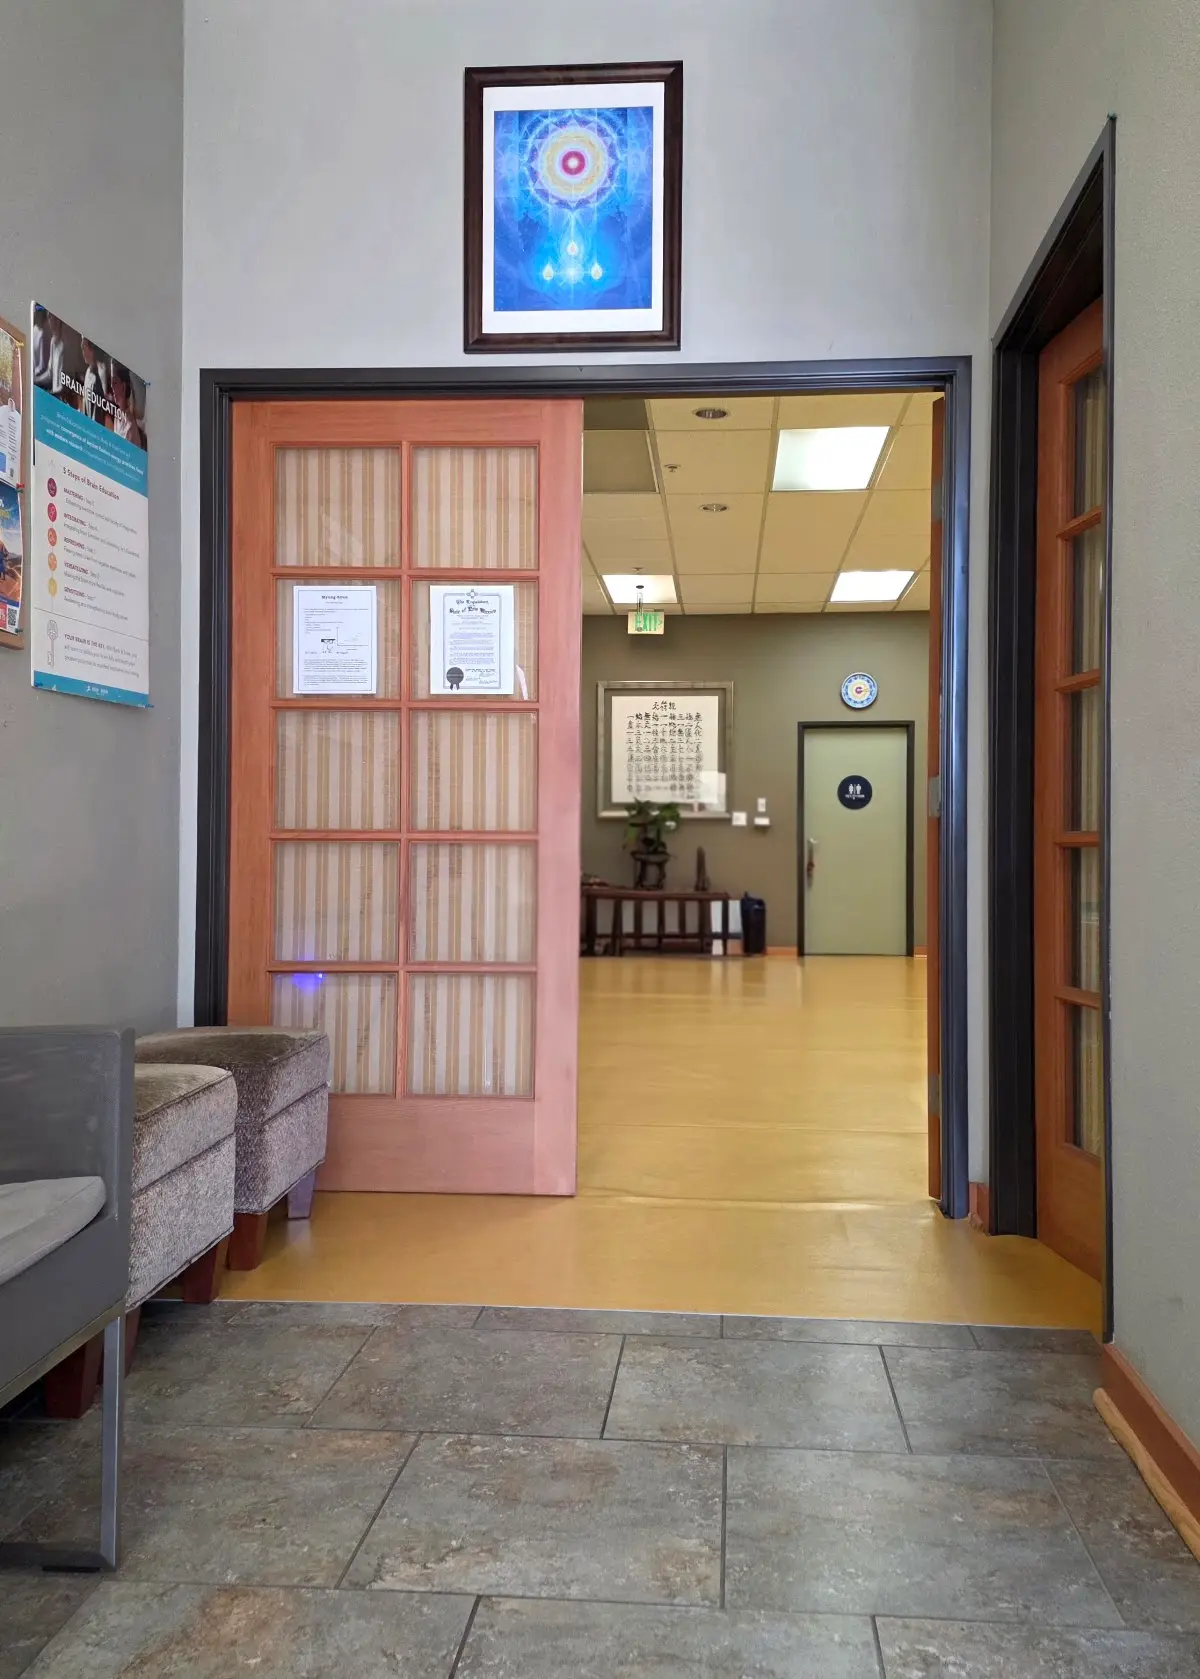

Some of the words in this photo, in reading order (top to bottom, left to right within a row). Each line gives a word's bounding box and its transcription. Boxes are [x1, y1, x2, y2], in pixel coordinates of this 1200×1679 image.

[60, 371, 85, 398] BRAIN
[86, 388, 128, 423] EDUCATION
[63, 465, 66, 474] 5
[67, 468, 80, 483] Steps
[81, 475, 85, 485] of
[86, 478, 97, 490] Brain
[99, 484, 119, 501] Education
[635, 612, 659, 631] EXIT
